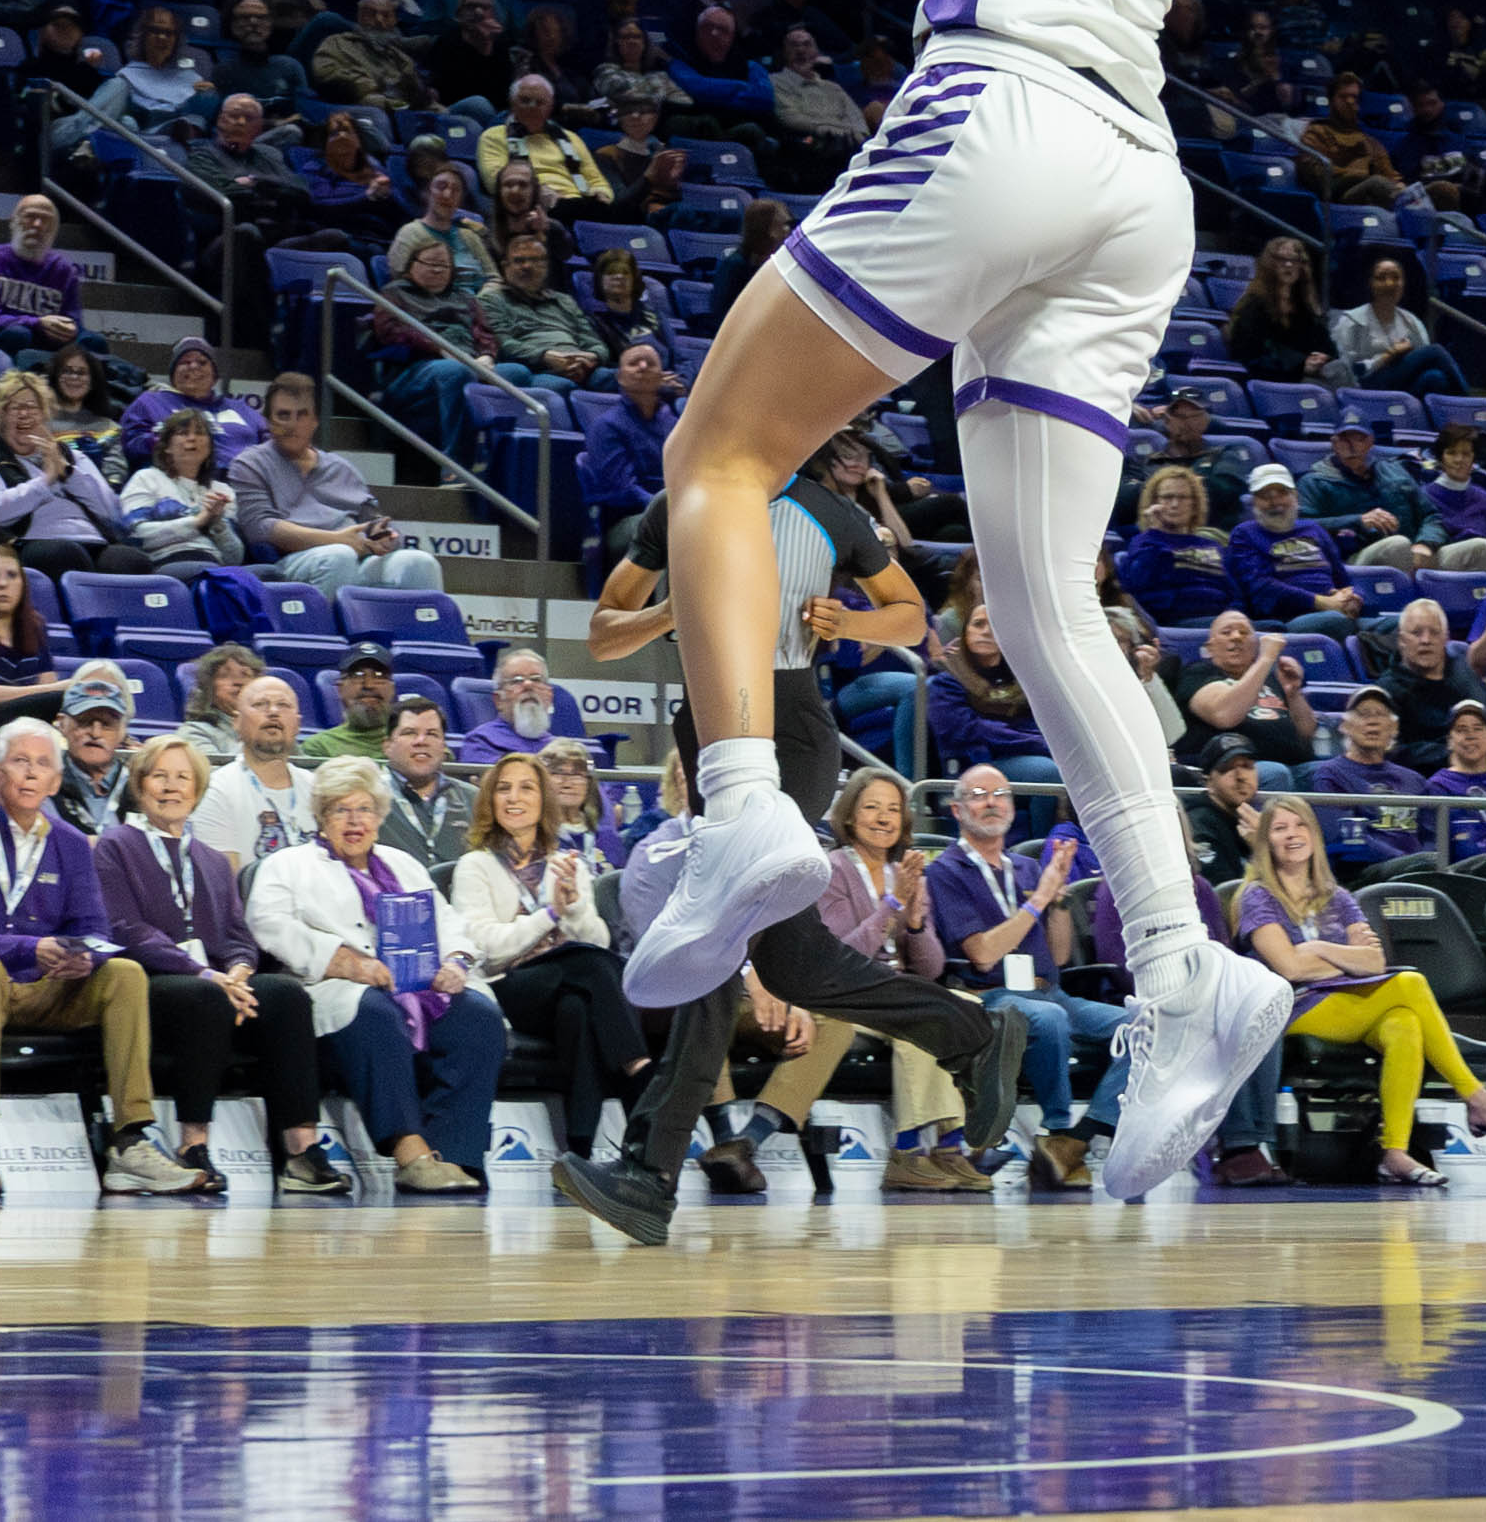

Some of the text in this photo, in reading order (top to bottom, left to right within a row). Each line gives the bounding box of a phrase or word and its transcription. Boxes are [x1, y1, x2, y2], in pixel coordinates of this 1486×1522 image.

[429, 536, 491, 556] YOU!
[466, 614, 539, 634] America
[582, 694, 643, 716] OOR
[31, 1144, 88, 1161] RIDGE
